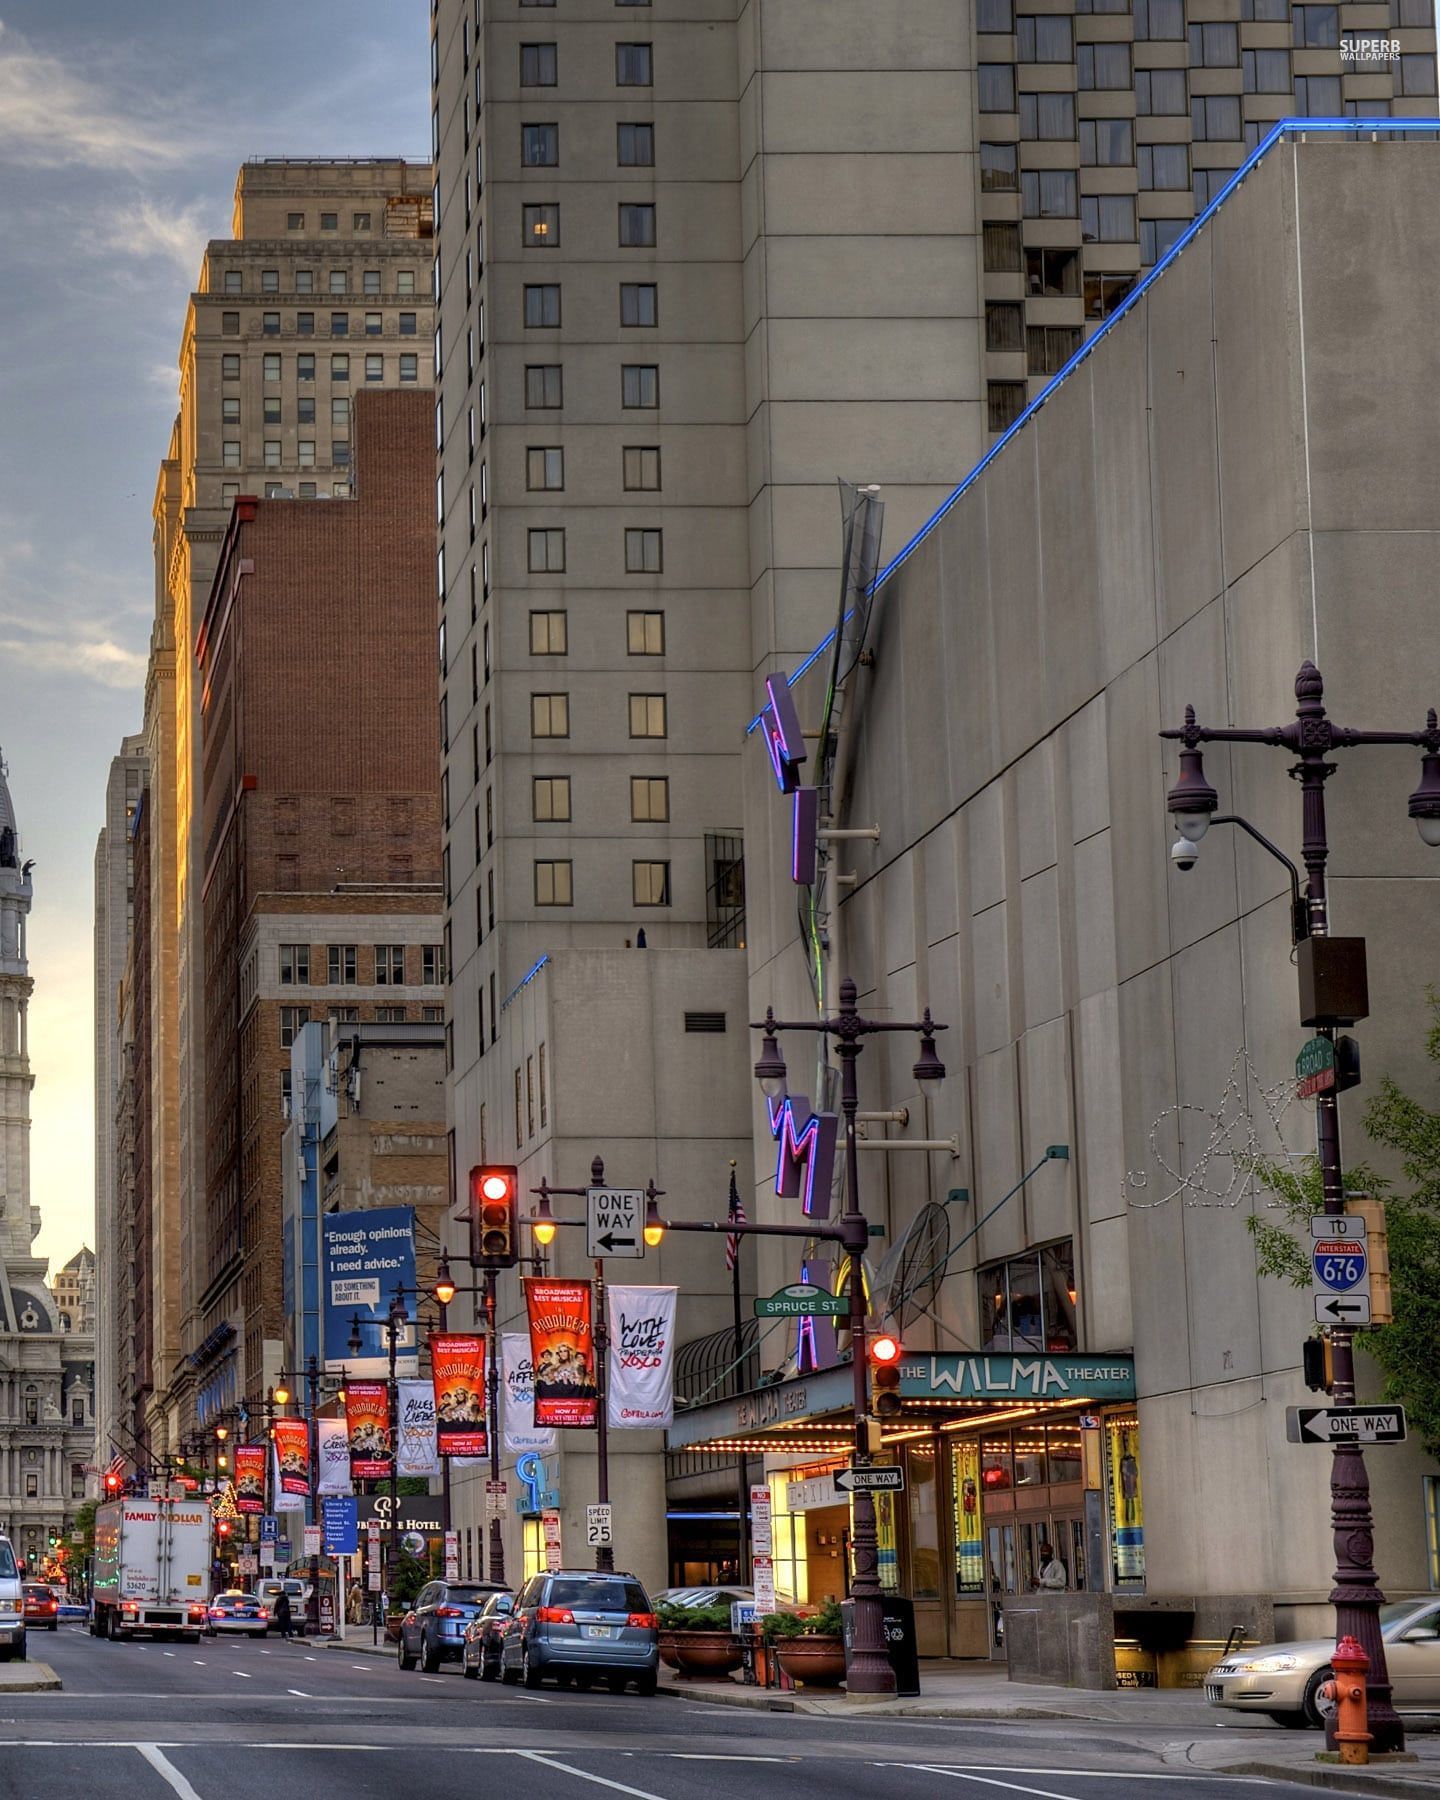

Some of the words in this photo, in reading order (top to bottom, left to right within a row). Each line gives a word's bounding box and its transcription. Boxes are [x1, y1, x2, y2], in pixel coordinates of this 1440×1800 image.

[598, 1194, 634, 1211] ONE
[596, 1213, 635, 1229] WAY
[1329, 1220, 1347, 1234] TO
[368, 1226, 412, 1241] opinions
[329, 1243, 369, 1256] already.
[1318, 1244, 1361, 1254] INTERSTATE
[330, 1262, 334, 1272] I
[337, 1260, 361, 1272] need
[1323, 1257, 1358, 1282] 676
[334, 1283, 343, 1292] DO
[344, 1281, 376, 1291] SOMETHING
[534, 1288, 582, 1296] BROADWAY'S
[334, 1292, 353, 1302] ABOUT
[534, 1295, 550, 1303] BEST
[551, 1295, 584, 1303] MUSICAL!
[766, 1301, 817, 1312] SPRUCE
[821, 1301, 839, 1311] ST.
[532, 1314, 590, 1336] PRODUCERS
[619, 1313, 668, 1336] WITH
[620, 1331, 663, 1349] LOVE
[619, 1355, 662, 1370] XOXO
[435, 1362, 483, 1379] PRODUCERS
[899, 1366, 926, 1379] THE
[929, 1356, 1071, 1395] WILMA
[1064, 1366, 1130, 1380] THEATER
[406, 1398, 434, 1412] ALLES
[404, 1410, 437, 1424] LIEBE
[1330, 1417, 1359, 1433] ONE
[1363, 1415, 1393, 1431] WAY
[853, 1474, 873, 1484] ONE
[875, 1473, 895, 1483] WAY
[125, 1512, 157, 1522] FAMILY
[167, 1513, 203, 1523] DOLLAR
[588, 1508, 610, 1516] SPEED
[264, 1521, 275, 1533] H
[590, 1517, 608, 1525] LIMIT
[588, 1526, 611, 1541] 25
[1121, 1679, 1140, 1689] Daily
